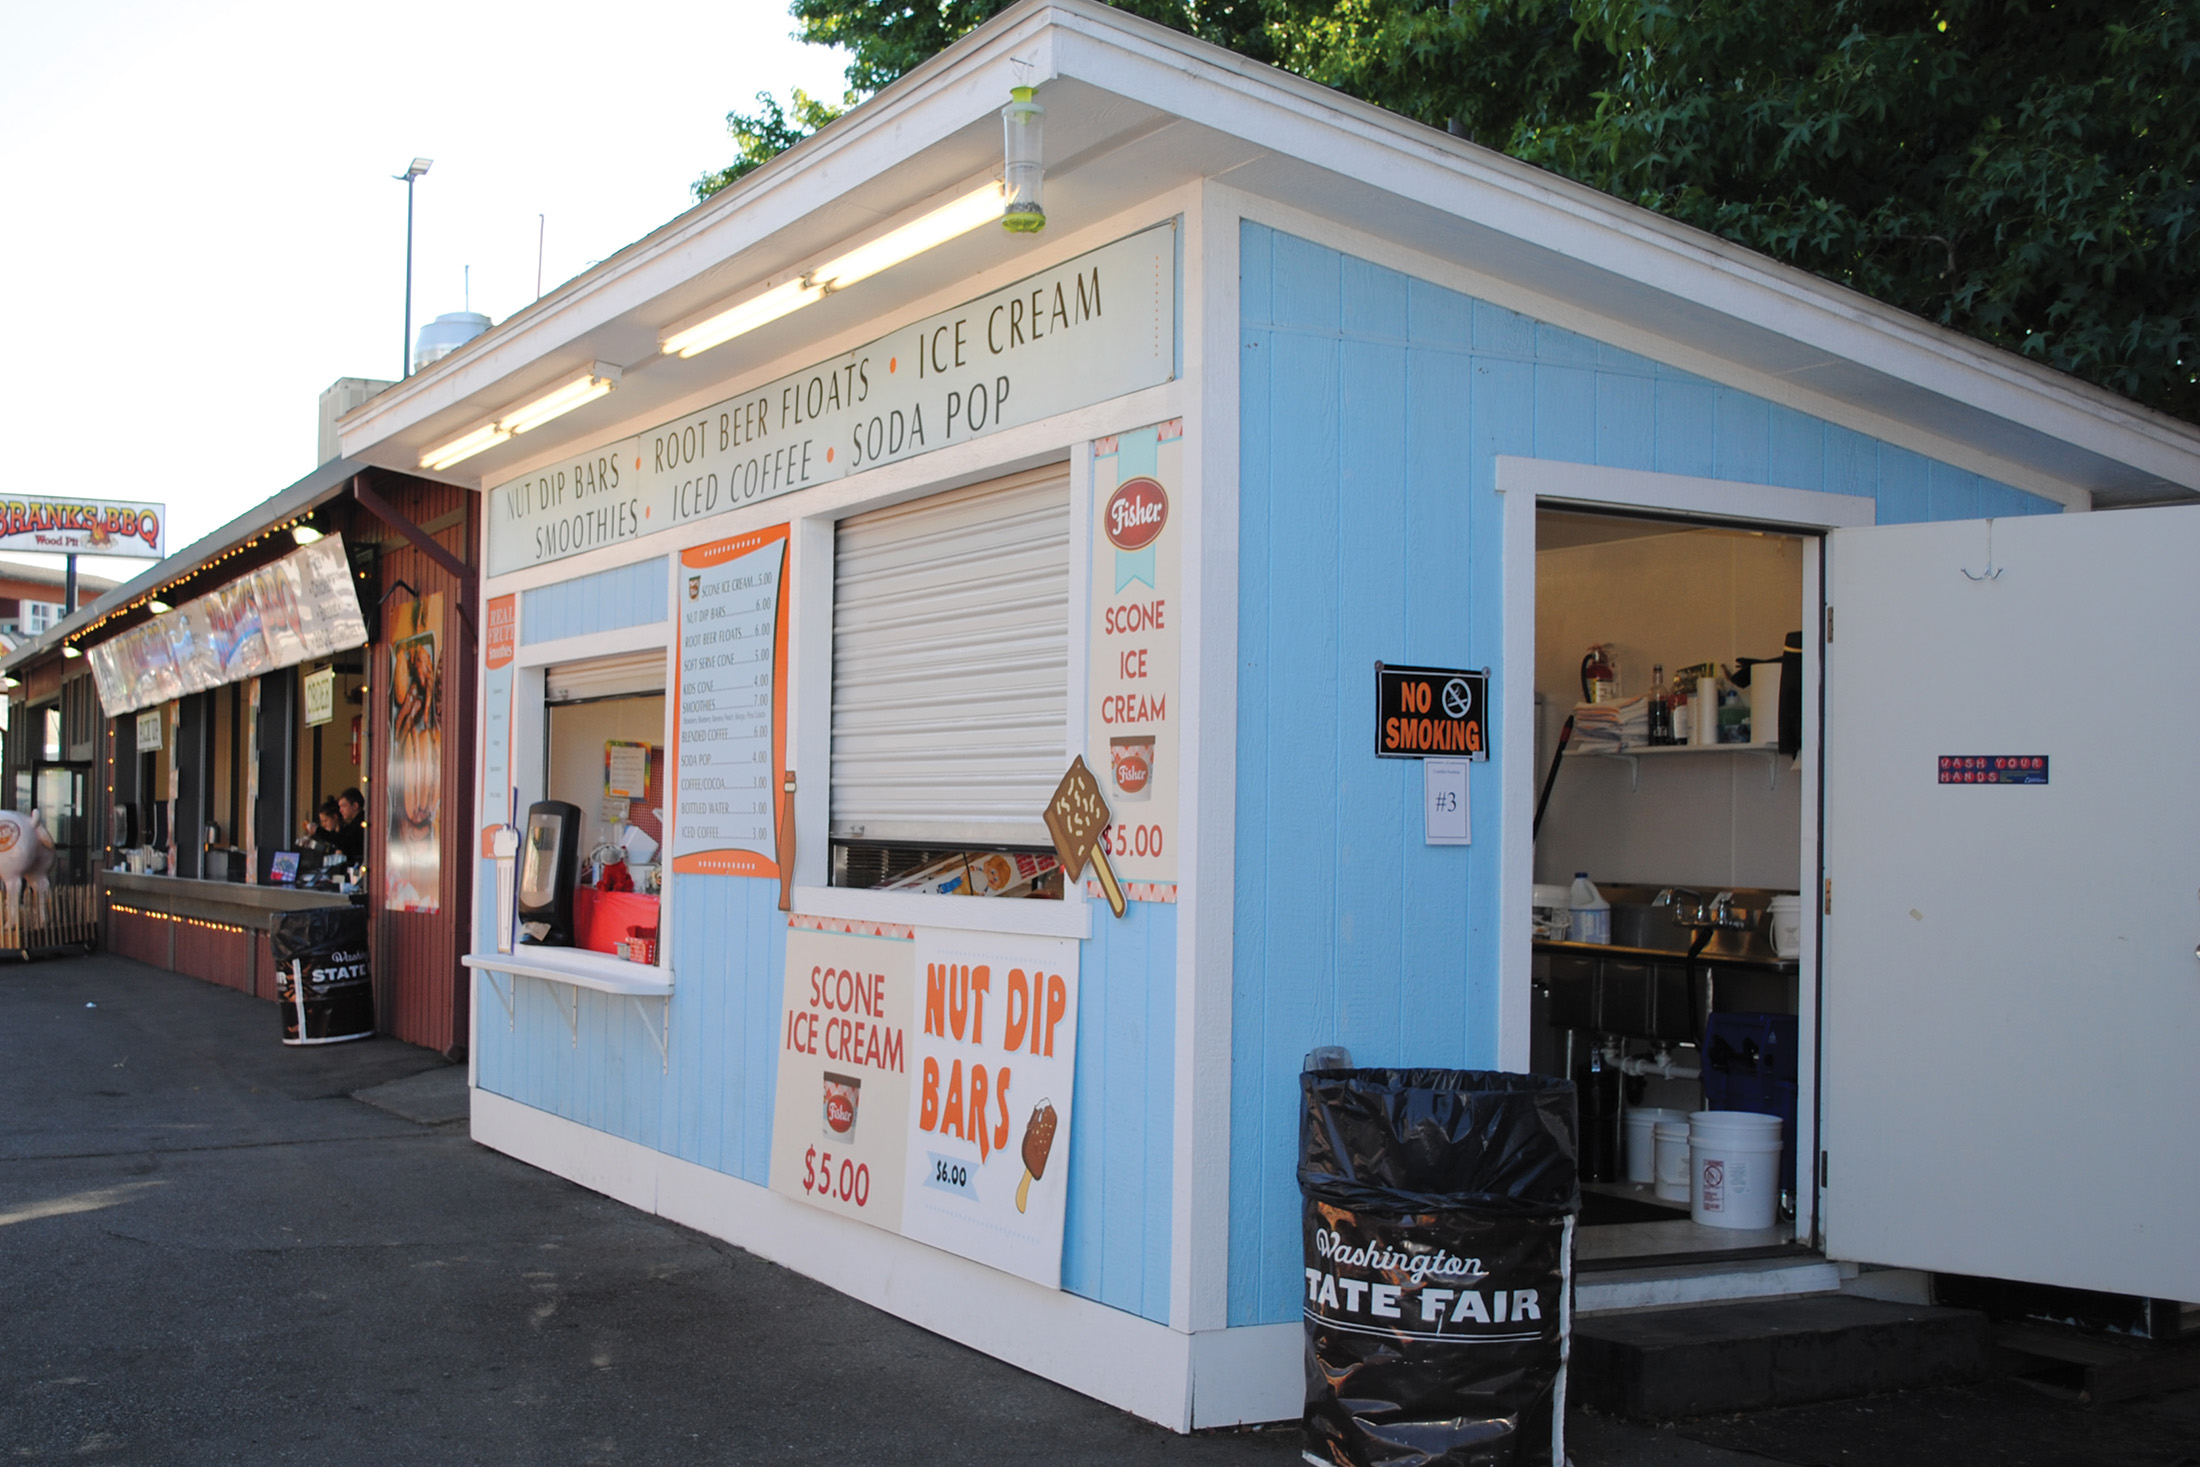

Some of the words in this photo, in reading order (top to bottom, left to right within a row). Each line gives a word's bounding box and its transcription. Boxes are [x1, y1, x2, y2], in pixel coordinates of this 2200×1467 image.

[506, 490, 533, 523] NUT
[538, 474, 568, 511] DIP
[573, 452, 620, 501] BARS
[654, 418, 708, 475] ROOT
[718, 397, 769, 452] BEER
[781, 357, 871, 431] FLOATS
[918, 318, 968, 379] ICE
[986, 266, 1102, 356] CREAM
[535, 497, 639, 560] SMOOTHIES
[671, 472, 720, 522] ICED
[729, 440, 812, 509] COFFEE
[851, 402, 925, 468] SODA
[945, 375, 1013, 439] POP
[35, 534, 63, 546] Wood
[105, 507, 159, 549] BBQ
[702, 581, 720, 598] SCONE
[721, 580, 730, 593] ICE
[490, 606, 515, 626] REAL
[686, 608, 699, 624] NUT
[699, 608, 710, 622] DIP
[755, 597, 771, 611] 6.00
[1105, 600, 1165, 635] SCONE
[488, 624, 514, 644] FRUIT
[685, 634, 701, 648] ROOT
[702, 630, 717, 645] BEER
[754, 623, 771, 636] 6.00
[684, 657, 699, 672] SOFT
[699, 655, 716, 669] SERVE
[1120, 649, 1148, 679] ICE
[683, 682, 696, 695] KIDS
[753, 674, 769, 687] 4.00
[1401, 681, 1432, 714] NO
[1102, 693, 1166, 724] CREAM
[681, 729, 706, 743] BLENDED
[753, 725, 768, 738] 6.00
[1385, 717, 1480, 752] SMOKING
[681, 754, 697, 767] SODA
[699, 753, 711, 766] POP
[752, 751, 768, 764] 4.00
[1941, 758, 1986, 769] WASH
[1996, 758, 2041, 769] YOUR
[752, 776, 768, 789] 3.00
[1118, 765, 1146, 782] Fisher
[1941, 771, 1997, 782] HANDS
[681, 802, 707, 815] BOTTLED
[752, 802, 768, 815] 3.00
[1435, 791, 1457, 812] #3
[681, 826, 695, 839] ICED
[752, 827, 768, 841] 3.00
[1102, 824, 1163, 857] $5.00
[312, 964, 366, 983] STATE
[810, 966, 885, 1018] SCONE
[924, 963, 990, 1045] NUT
[1003, 968, 1066, 1058] DIP
[786, 1010, 817, 1055] ICE
[825, 1016, 904, 1073] CREAM
[828, 1102, 852, 1122] Fisher
[919, 1056, 1011, 1166] BARS
[803, 1144, 870, 1207] $5.00
[936, 1160, 967, 1187] $6.00
[1316, 1228, 1490, 1284] Washington
[1305, 1267, 1401, 1318] TATE
[1416, 1288, 1541, 1323] FAIR
